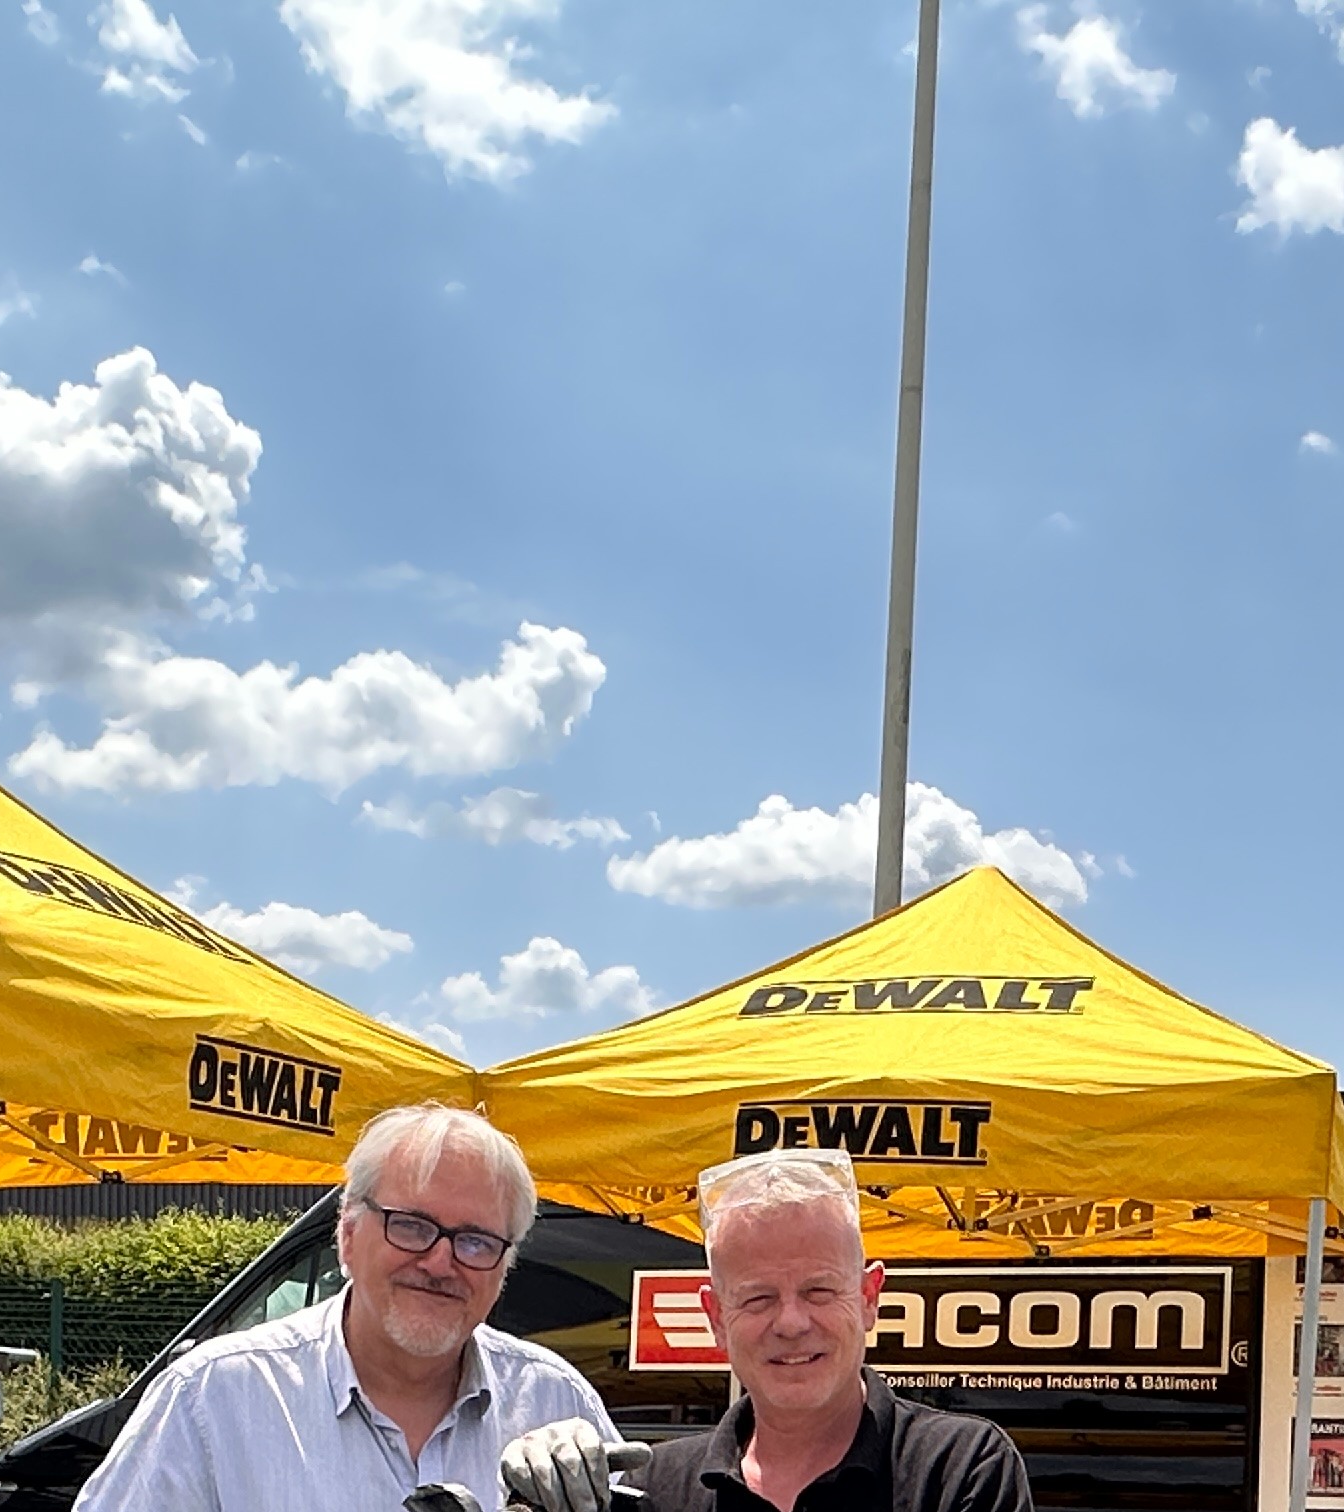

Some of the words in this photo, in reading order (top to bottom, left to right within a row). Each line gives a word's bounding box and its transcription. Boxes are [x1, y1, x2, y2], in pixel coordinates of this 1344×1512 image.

[739, 977, 1094, 1014] DEWALT
[190, 1045, 341, 1128] DEWALT
[734, 1105, 992, 1158] DEWALT
[960, 1373, 1043, 1394] Technique
[1047, 1373, 1120, 1390] Industrie
[1125, 1374, 1138, 1390] &
[1142, 1373, 1219, 1391] Bâtiment
